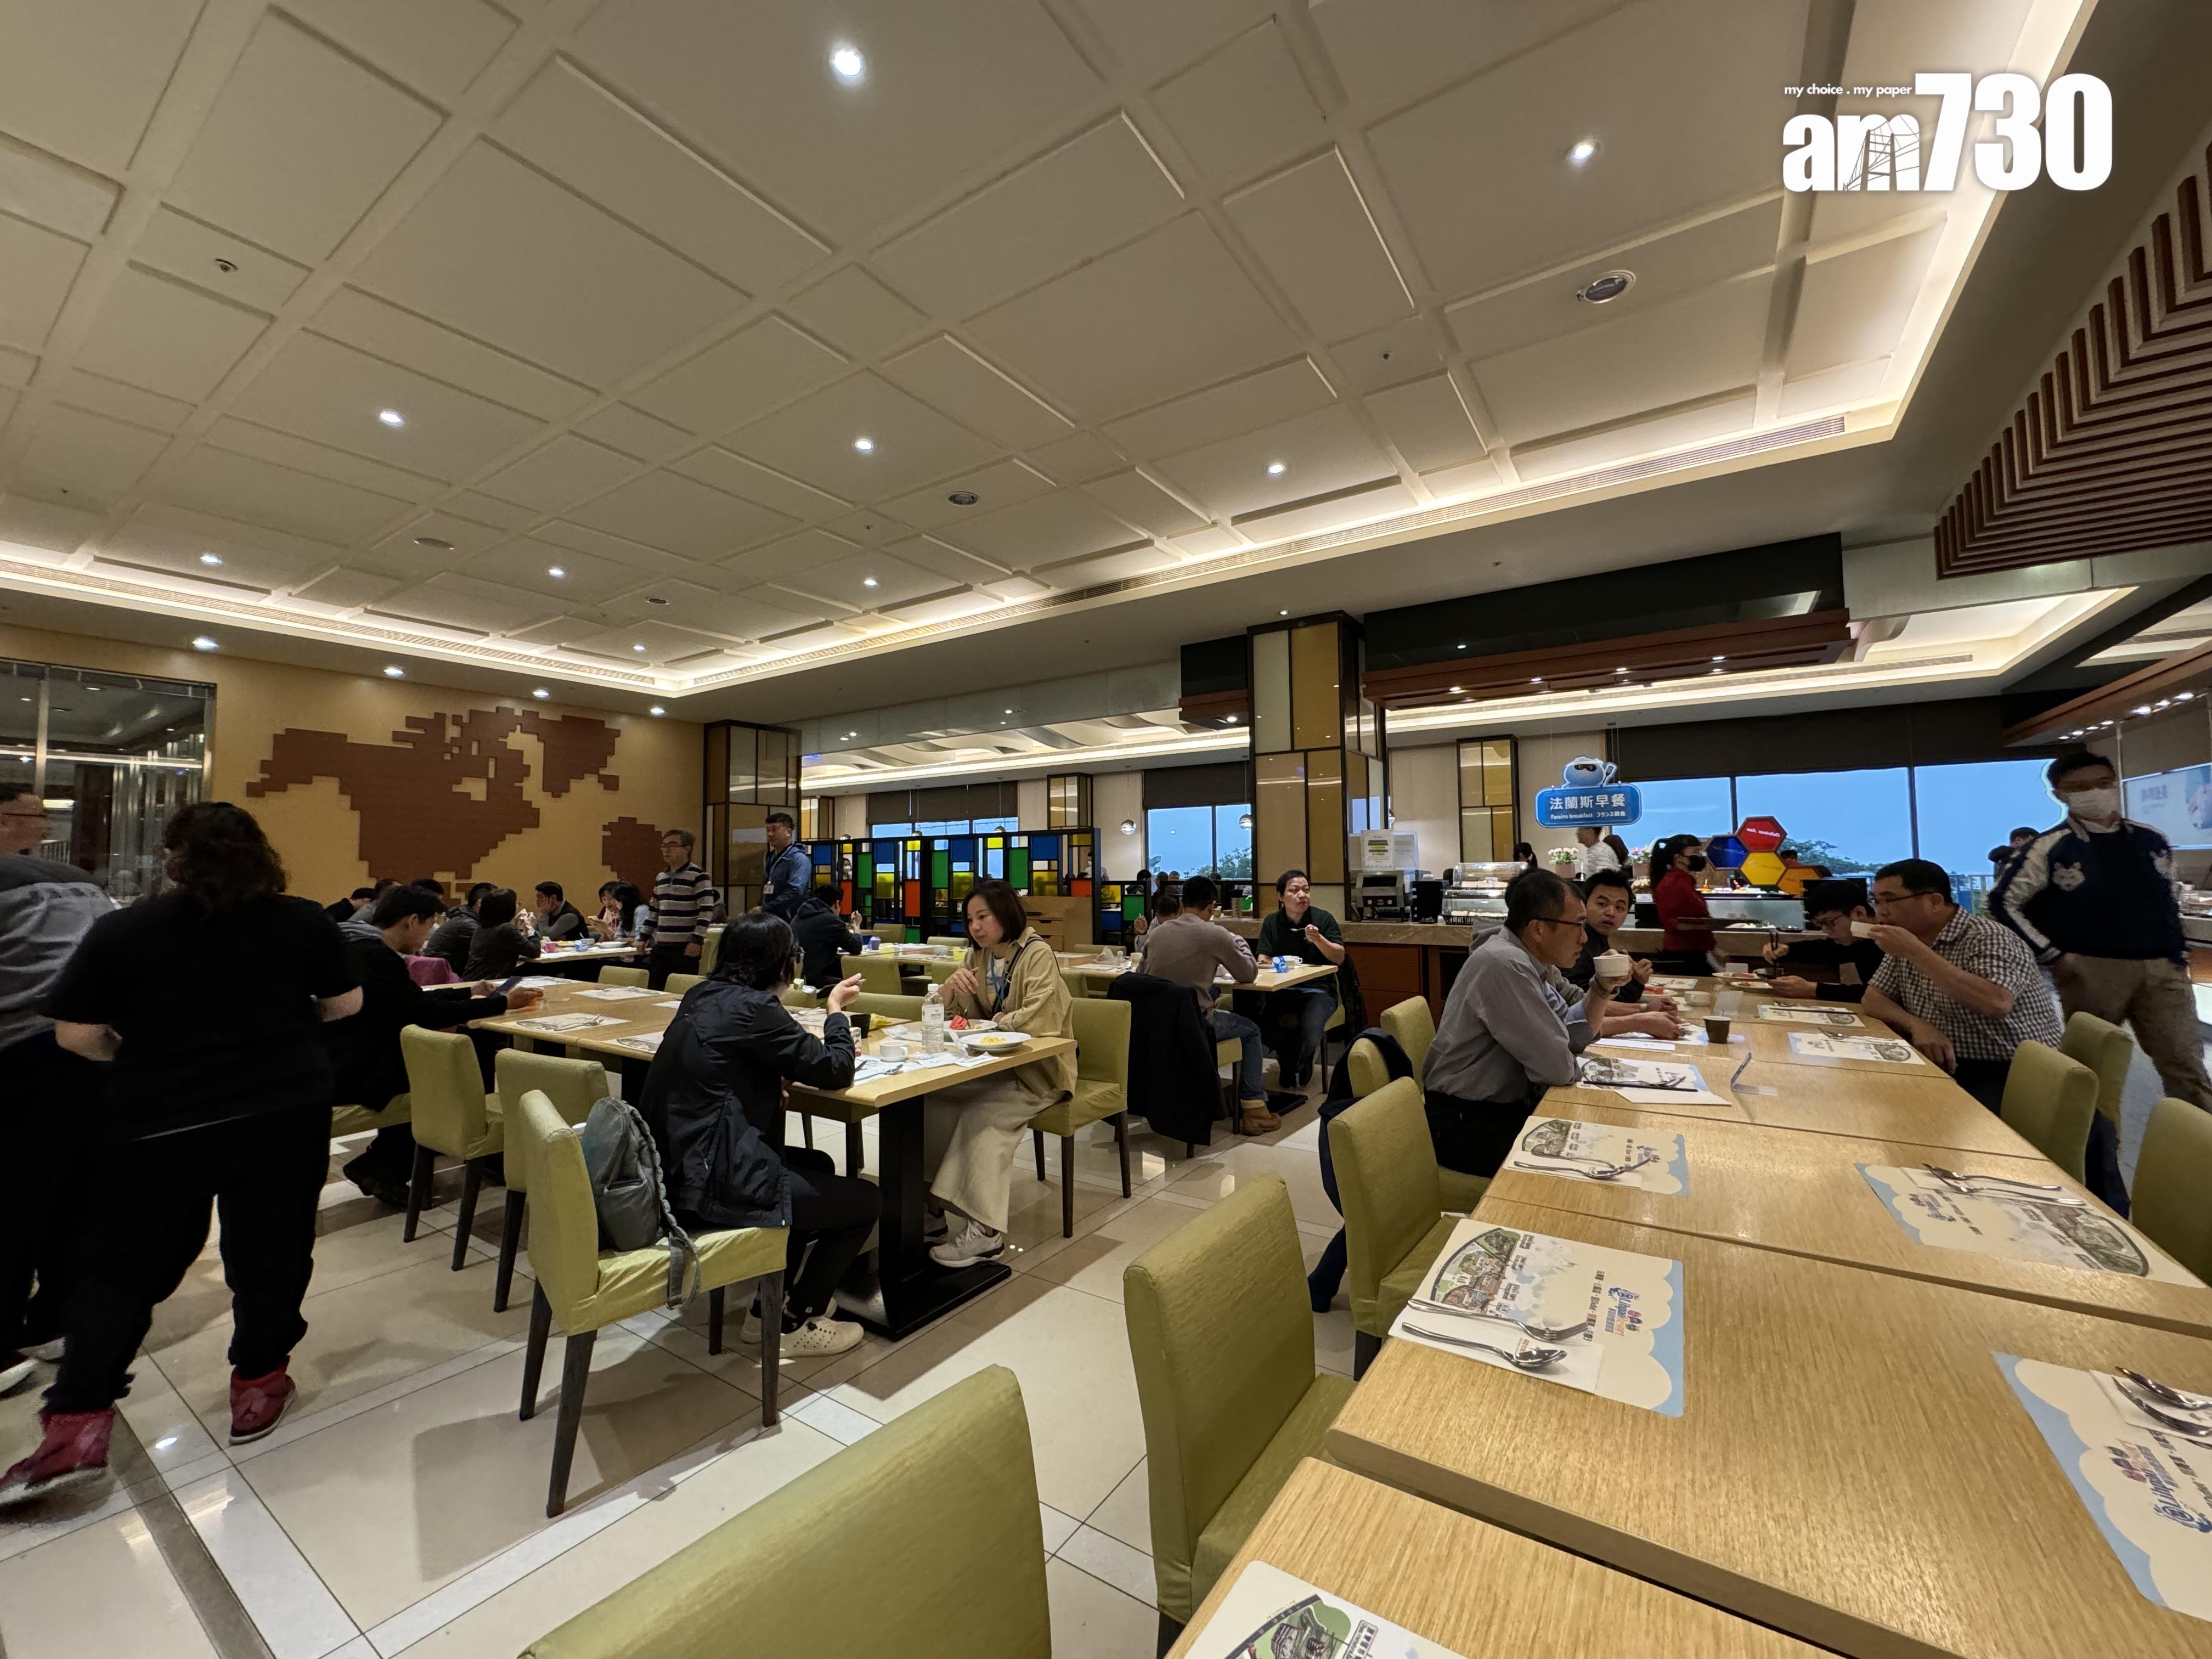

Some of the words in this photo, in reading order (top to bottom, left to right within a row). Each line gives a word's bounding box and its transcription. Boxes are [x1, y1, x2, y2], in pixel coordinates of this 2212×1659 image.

[1549, 793, 1626, 810] 法蘭斯早餐
